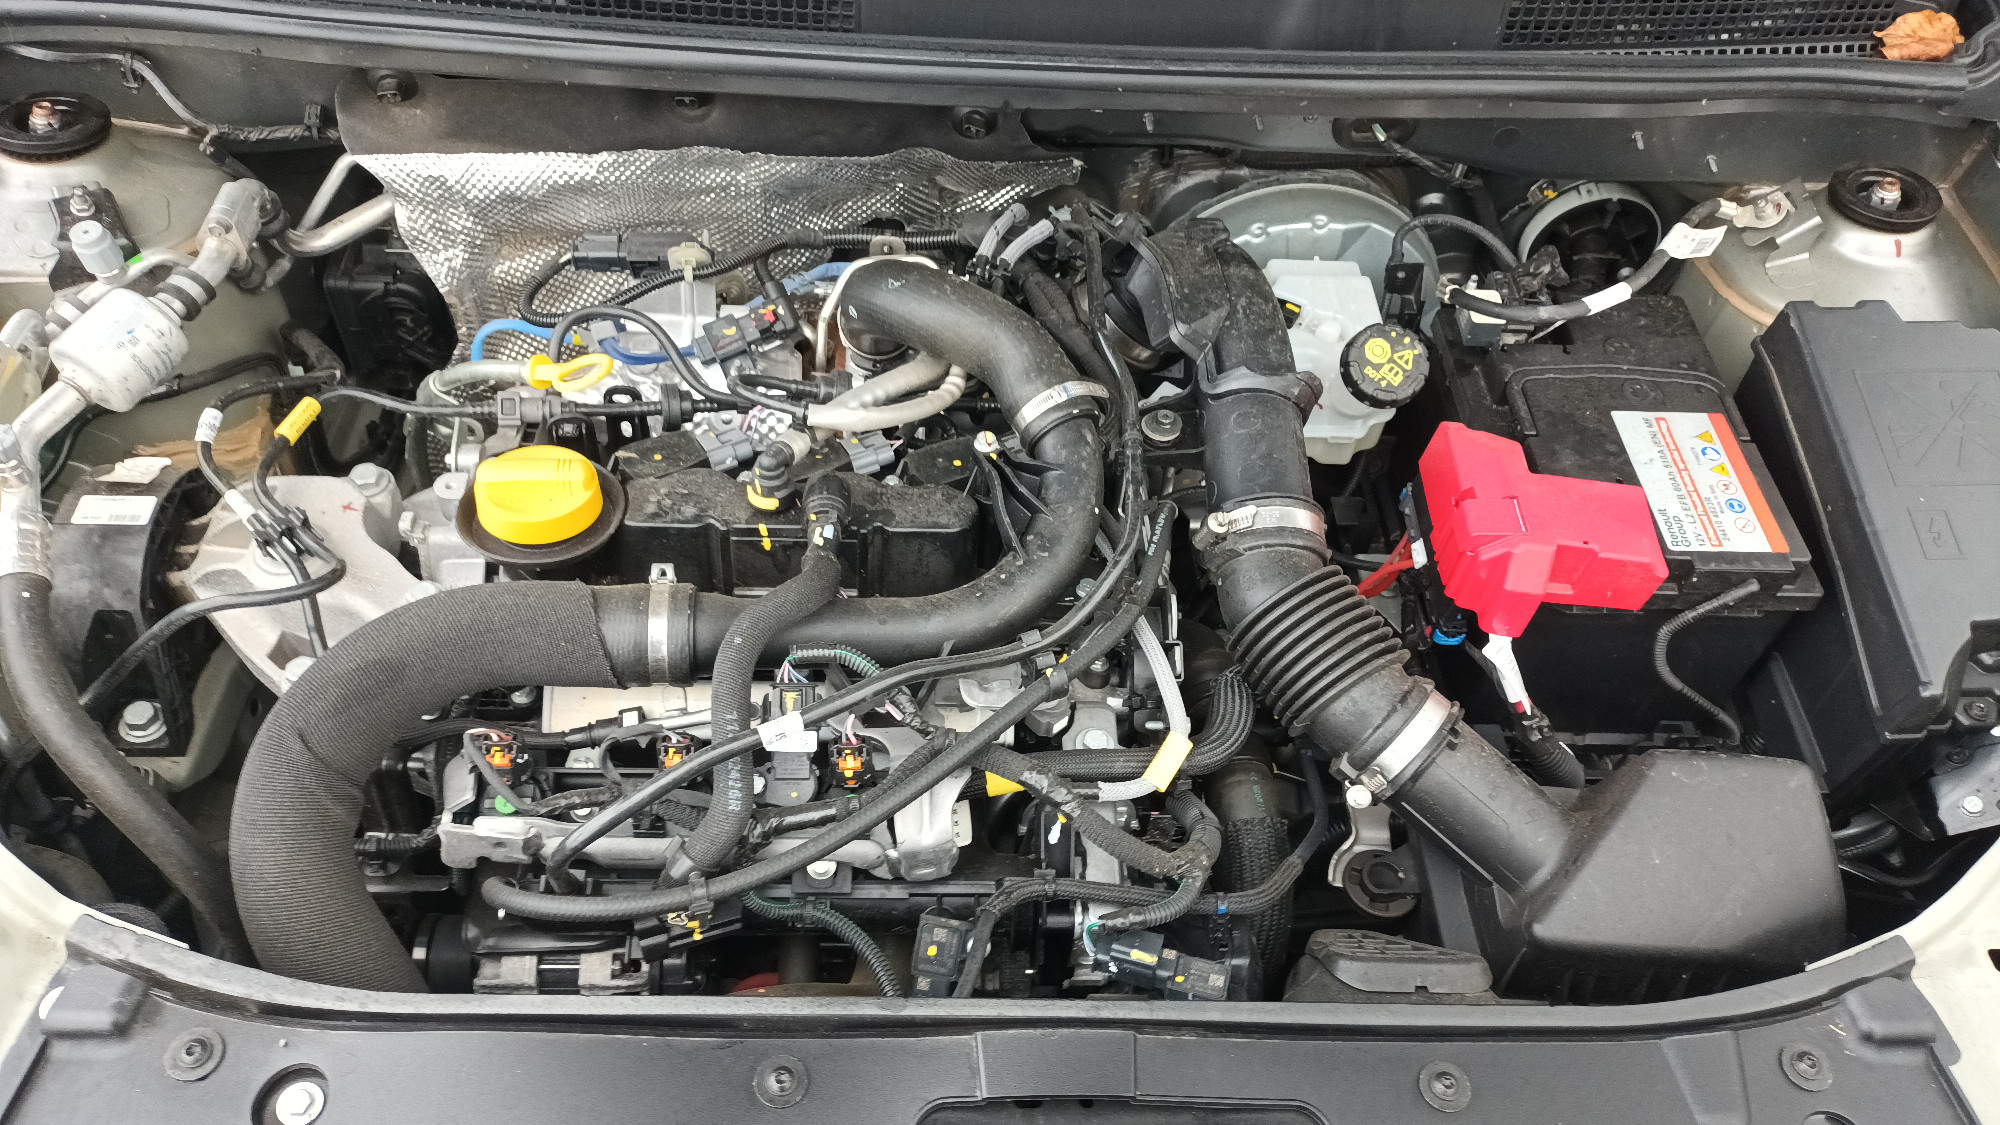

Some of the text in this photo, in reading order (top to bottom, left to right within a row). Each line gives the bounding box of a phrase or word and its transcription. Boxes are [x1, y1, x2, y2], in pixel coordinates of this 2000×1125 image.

[1364, 366, 1382, 382] DOT
[1676, 494, 1691, 511] EFB
[1685, 513, 1697, 524] L2
[1657, 508, 1682, 546] Renault
[1672, 515, 1692, 547] Group
[1693, 532, 1706, 546] 12V
